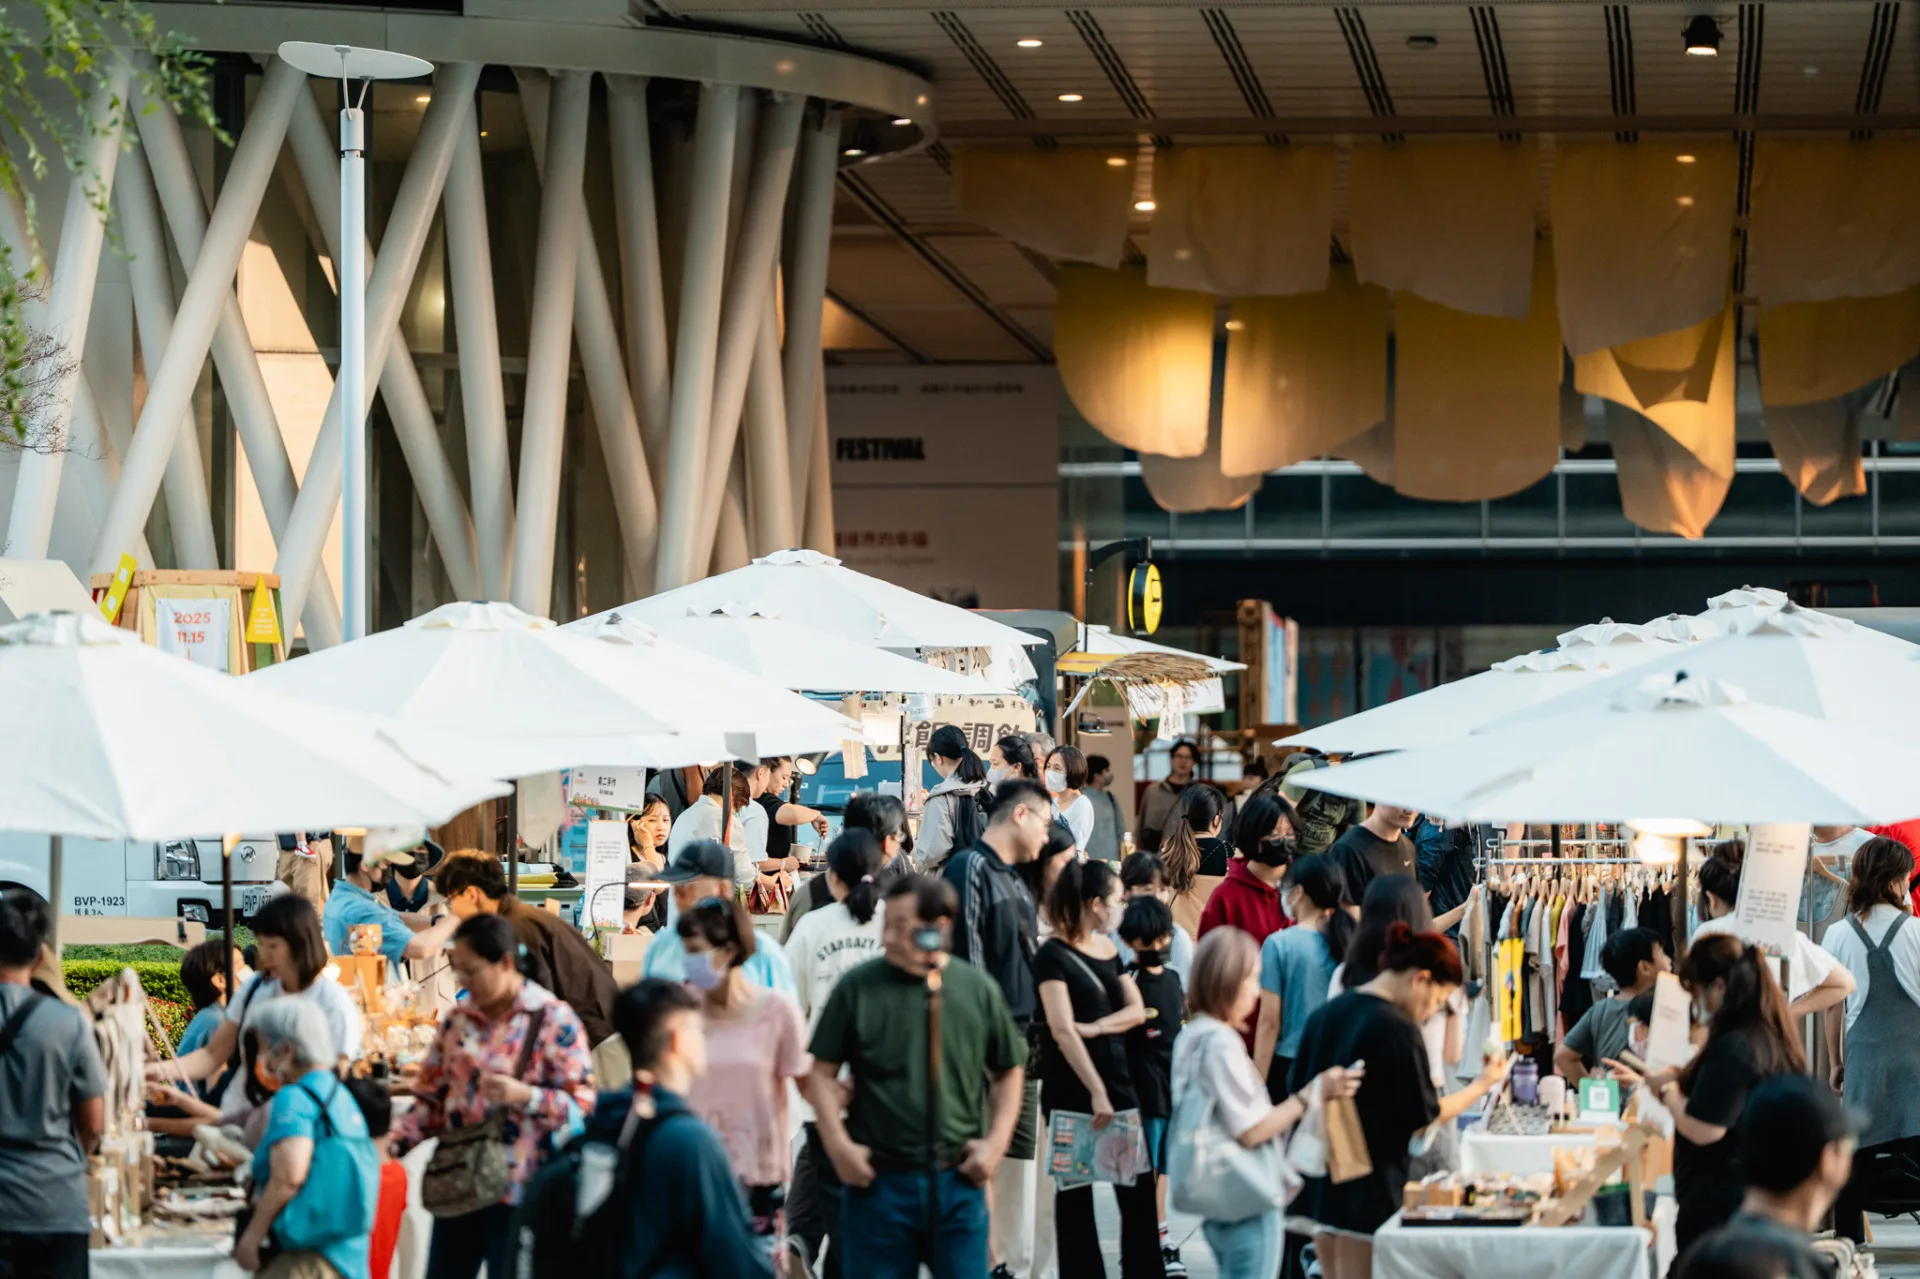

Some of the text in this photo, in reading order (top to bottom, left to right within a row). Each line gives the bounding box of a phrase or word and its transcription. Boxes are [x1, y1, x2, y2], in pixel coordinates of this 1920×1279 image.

[174, 611, 211, 625] 2025
[176, 631, 205, 644] 11.15
[74, 896, 125, 906] BVP-1923
